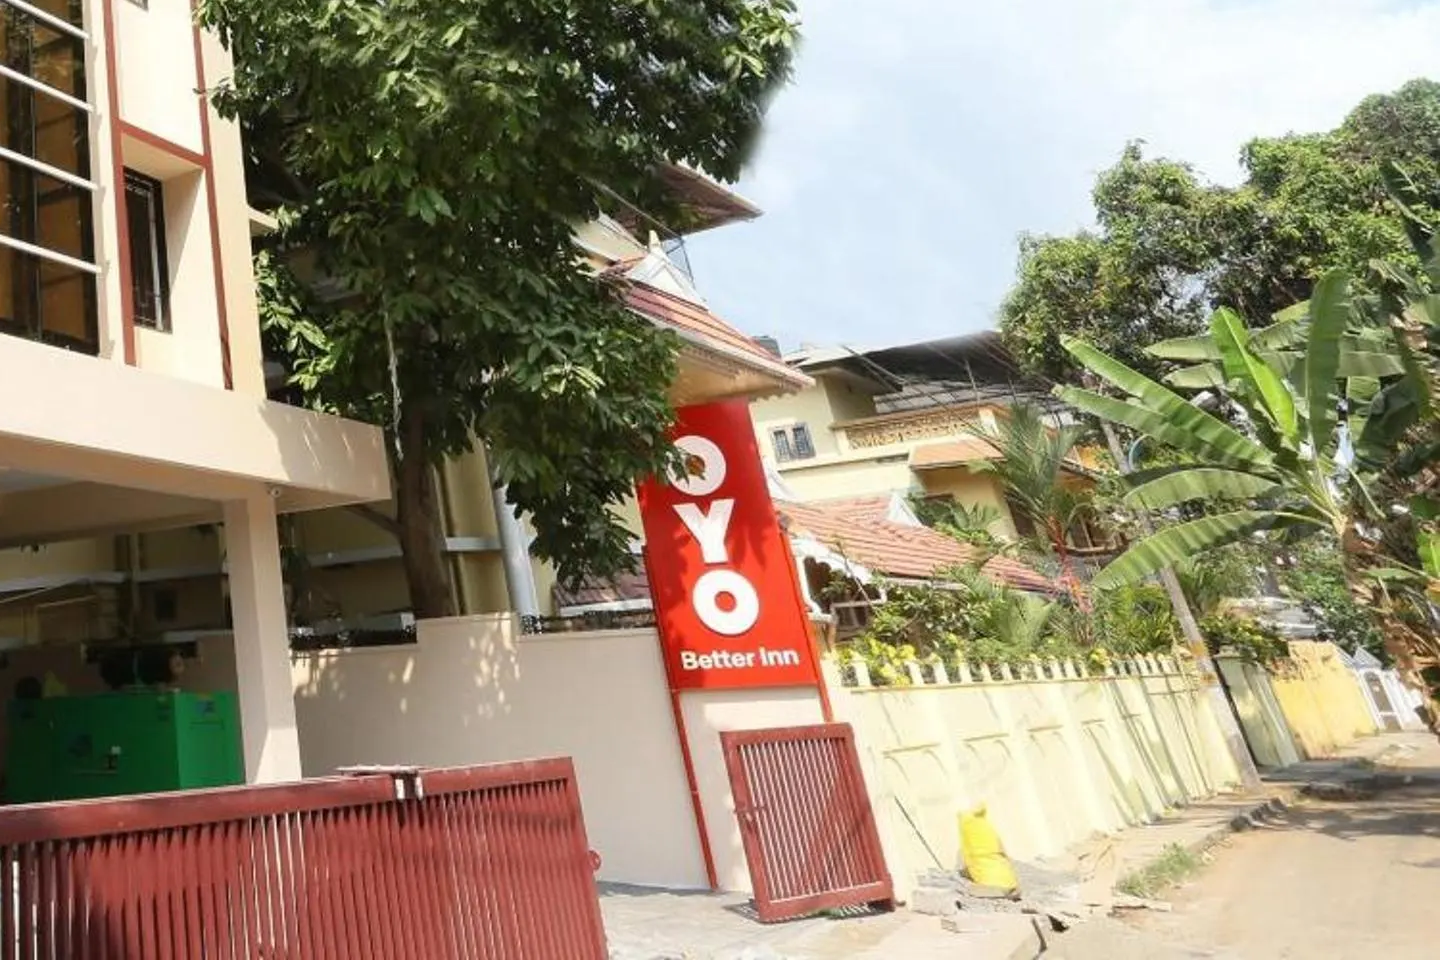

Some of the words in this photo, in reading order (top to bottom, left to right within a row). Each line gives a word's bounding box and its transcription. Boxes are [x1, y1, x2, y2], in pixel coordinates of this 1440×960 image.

[666, 435, 760, 635] OYO
[681, 649, 755, 670] Better
[759, 646, 800, 667] Inn
